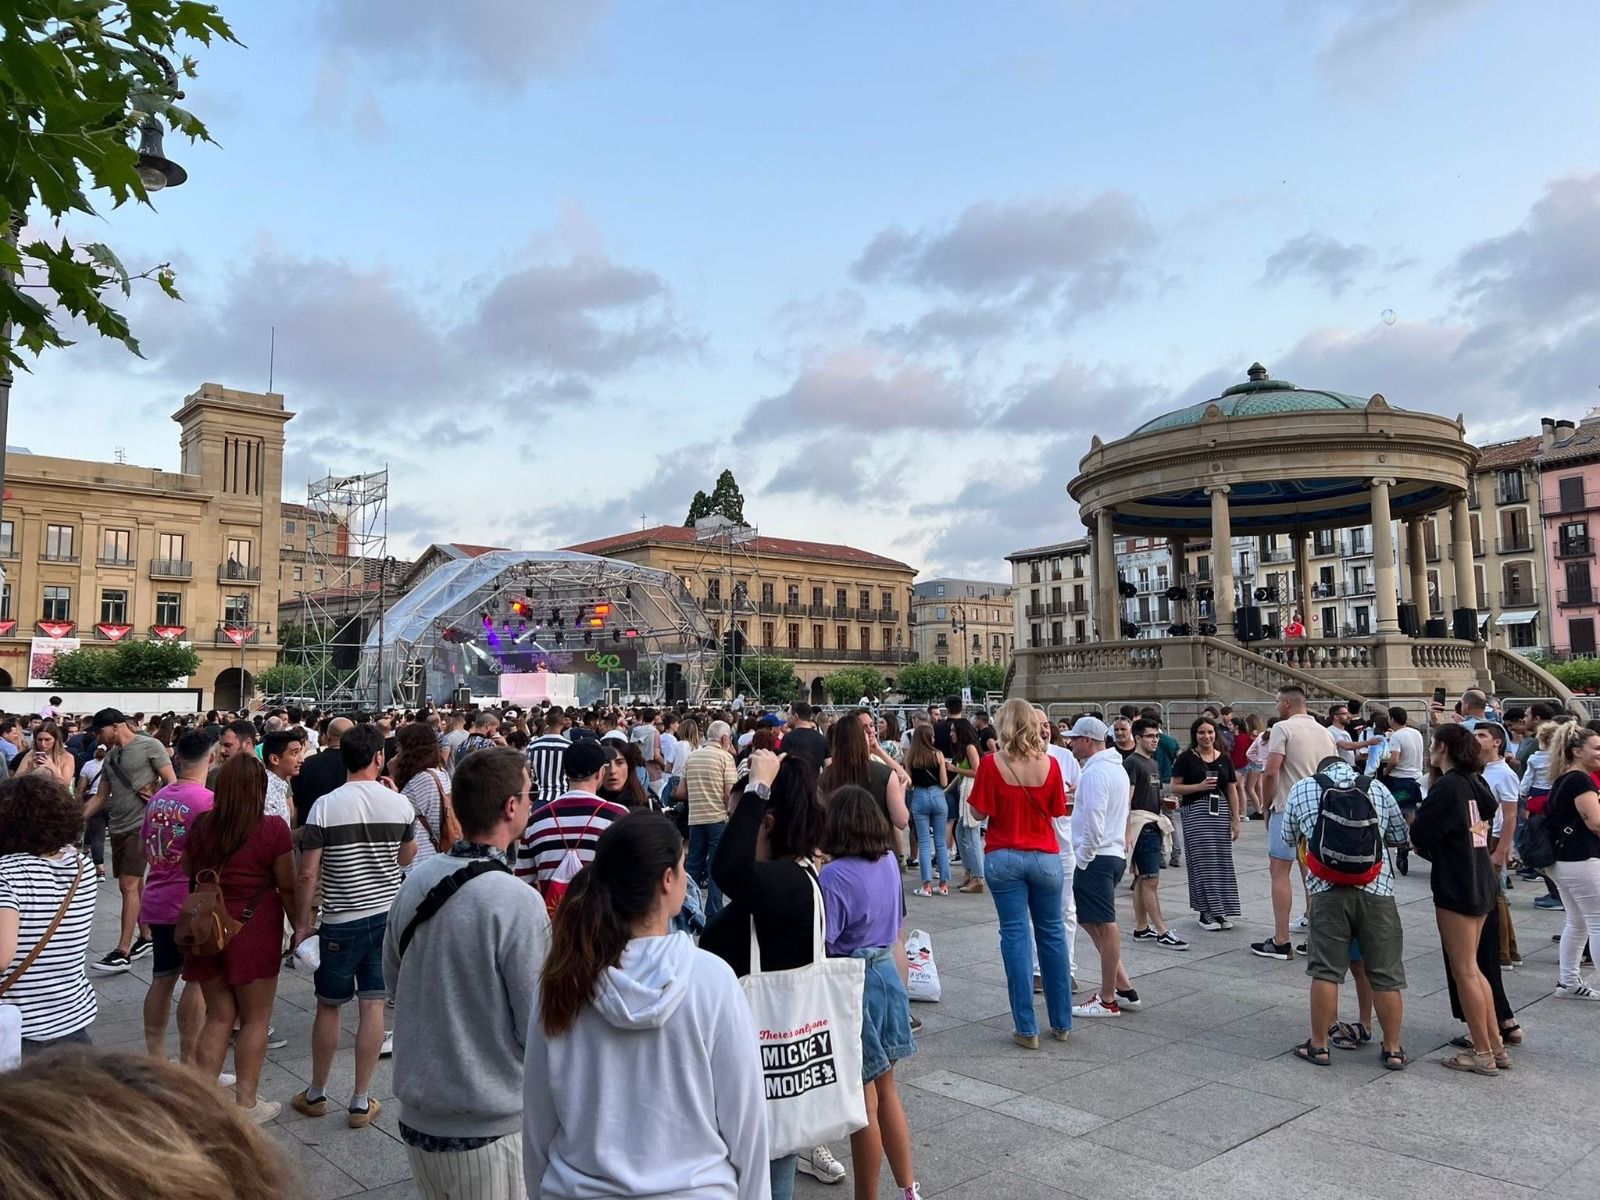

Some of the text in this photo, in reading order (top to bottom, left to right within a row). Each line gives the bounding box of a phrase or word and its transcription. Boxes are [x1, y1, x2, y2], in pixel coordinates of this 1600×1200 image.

[597, 654, 621, 672] 40
[759, 1019, 829, 1040] There's only one
[762, 1032, 829, 1068] MICKEY
[765, 1065, 822, 1098] MOUSE
